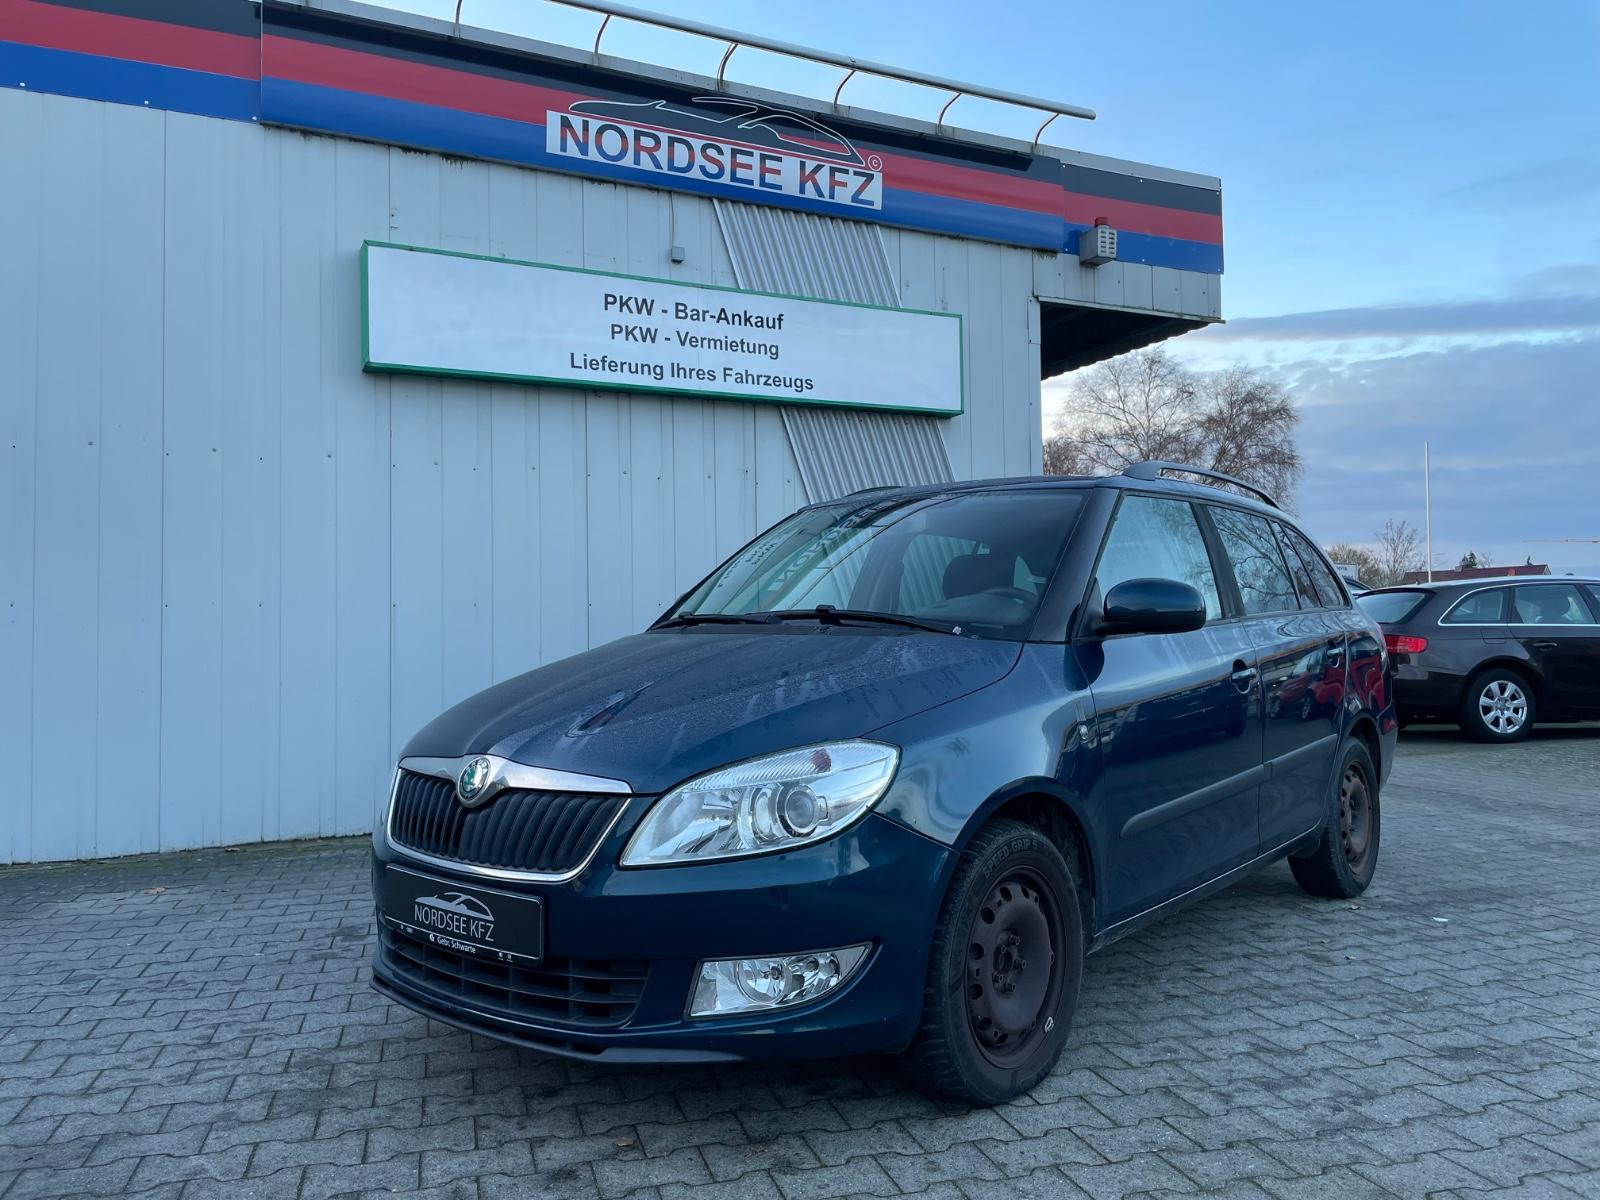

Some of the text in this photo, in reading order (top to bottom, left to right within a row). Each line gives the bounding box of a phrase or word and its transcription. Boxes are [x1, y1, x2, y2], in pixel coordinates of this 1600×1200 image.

[559, 114, 876, 207] NORDSEE KFZ
[603, 293, 655, 316] PKW
[674, 302, 785, 330] Bar-Ankauf
[610, 323, 659, 344] PKW
[676, 330, 780, 360] Vermietung
[570, 352, 814, 393] Lieferung Ihres Fahrzeugs
[414, 903, 495, 942] NORDSEE KFZ
[451, 939, 477, 954] Schwarte
